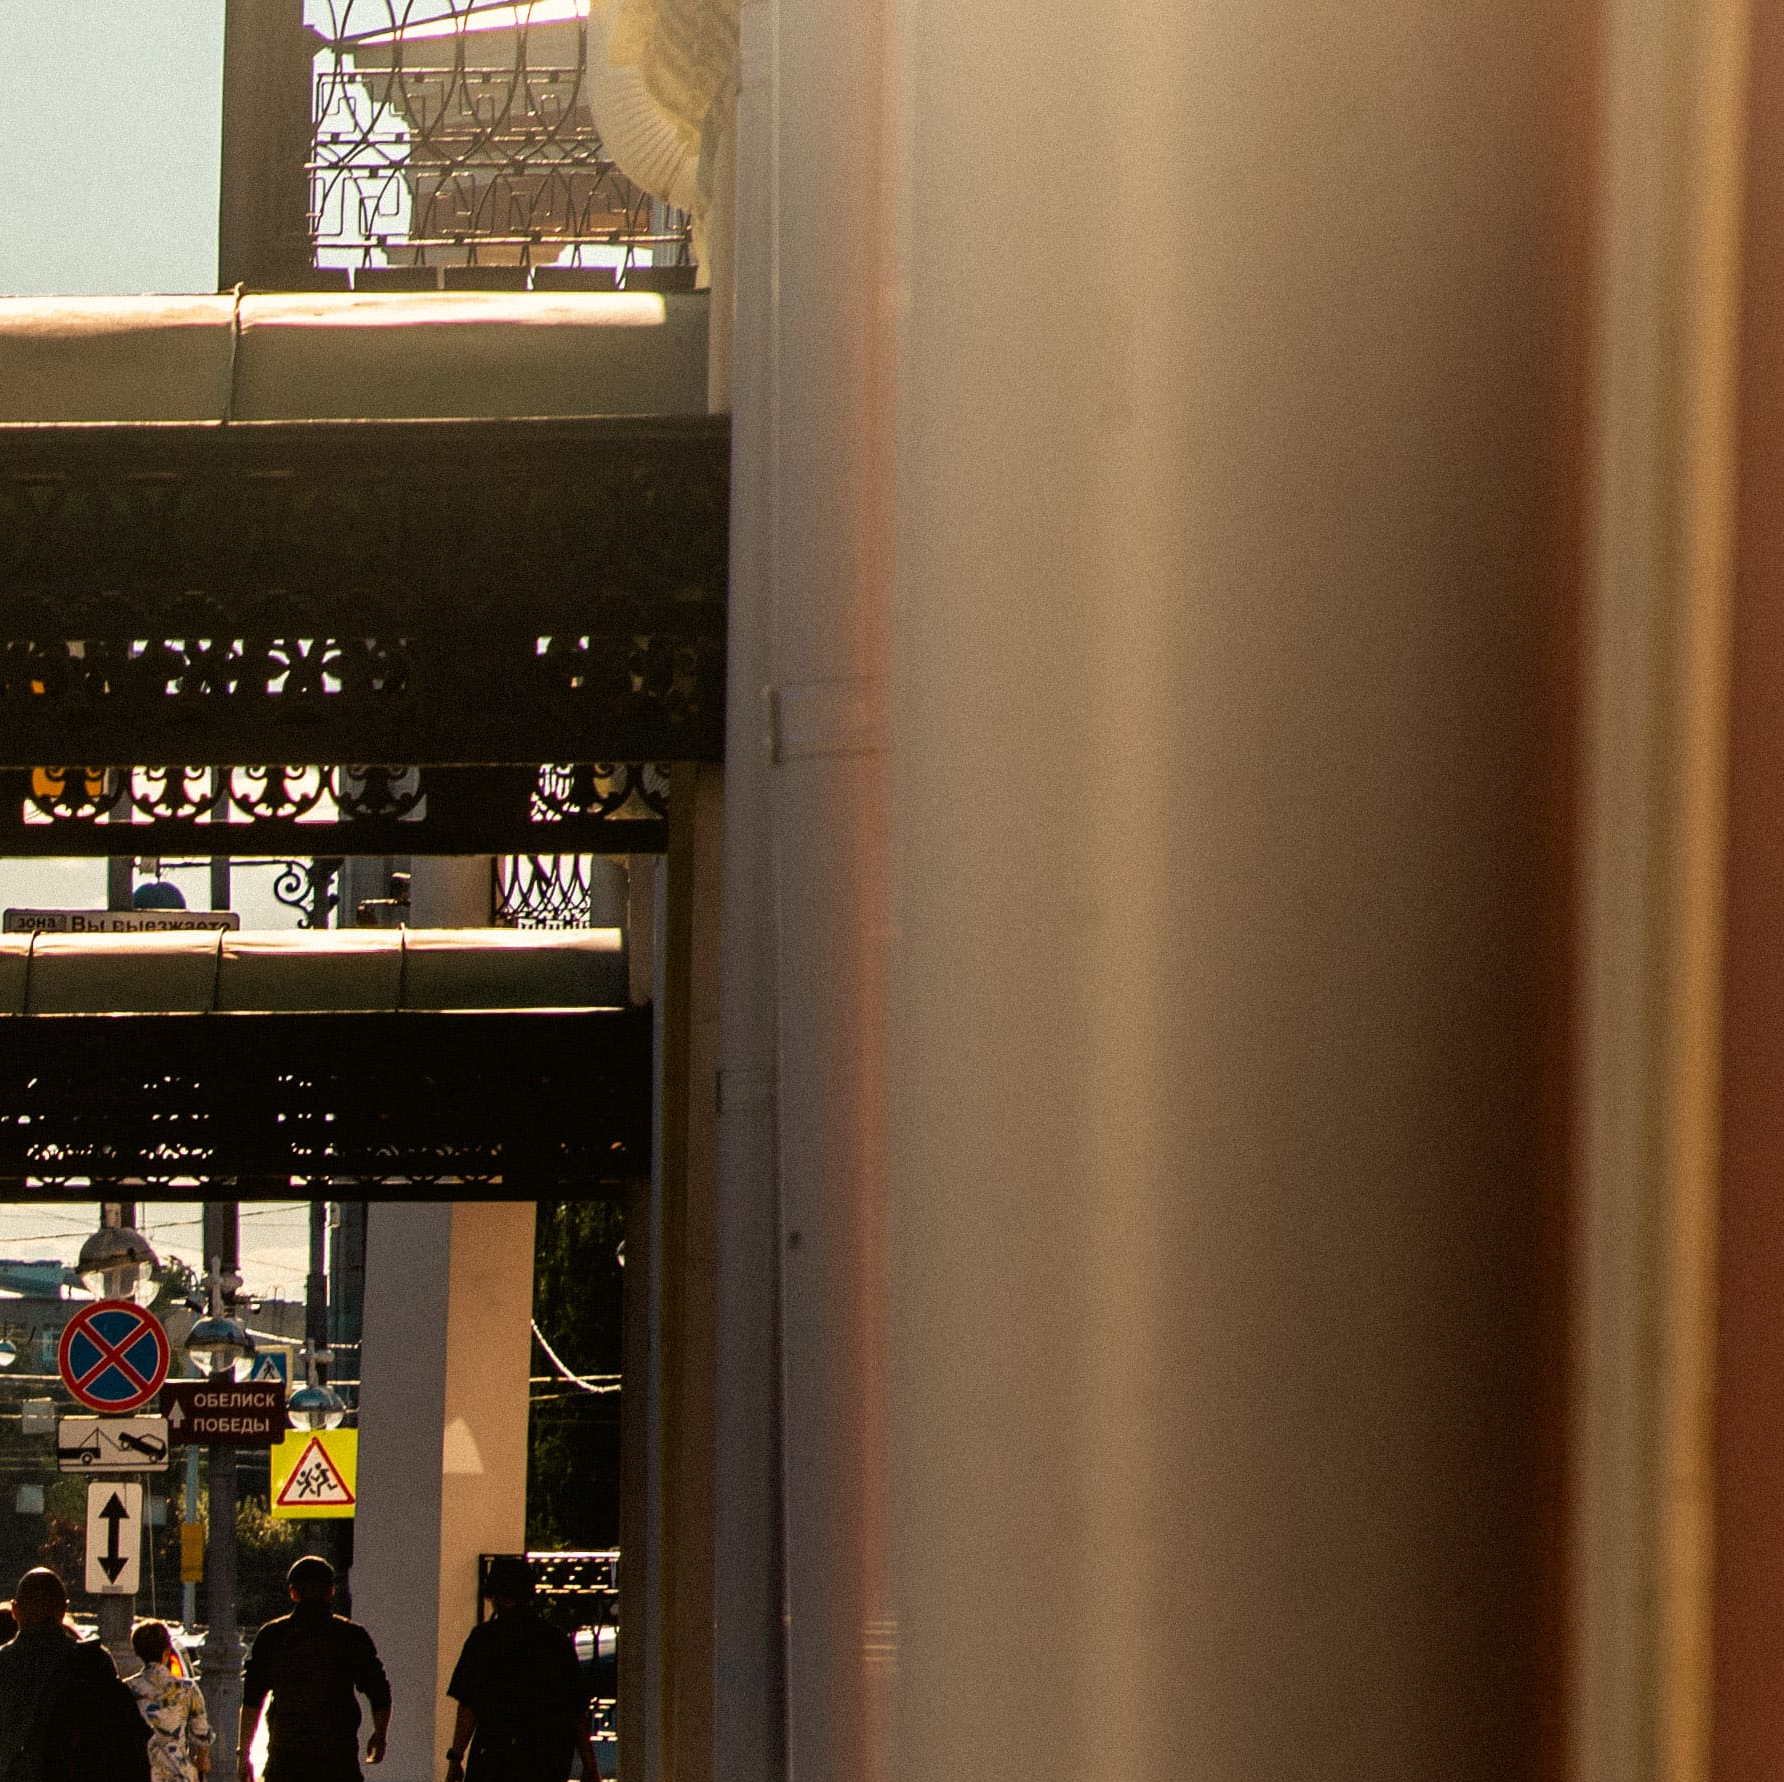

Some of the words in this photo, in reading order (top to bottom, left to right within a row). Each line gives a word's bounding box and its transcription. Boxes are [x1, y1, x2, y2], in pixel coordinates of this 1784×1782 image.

[71, 915, 105, 932] Вы
[194, 1393, 275, 1408] ОБЕЛИСК
[194, 1418, 270, 1435] ПОБЕДЫ
